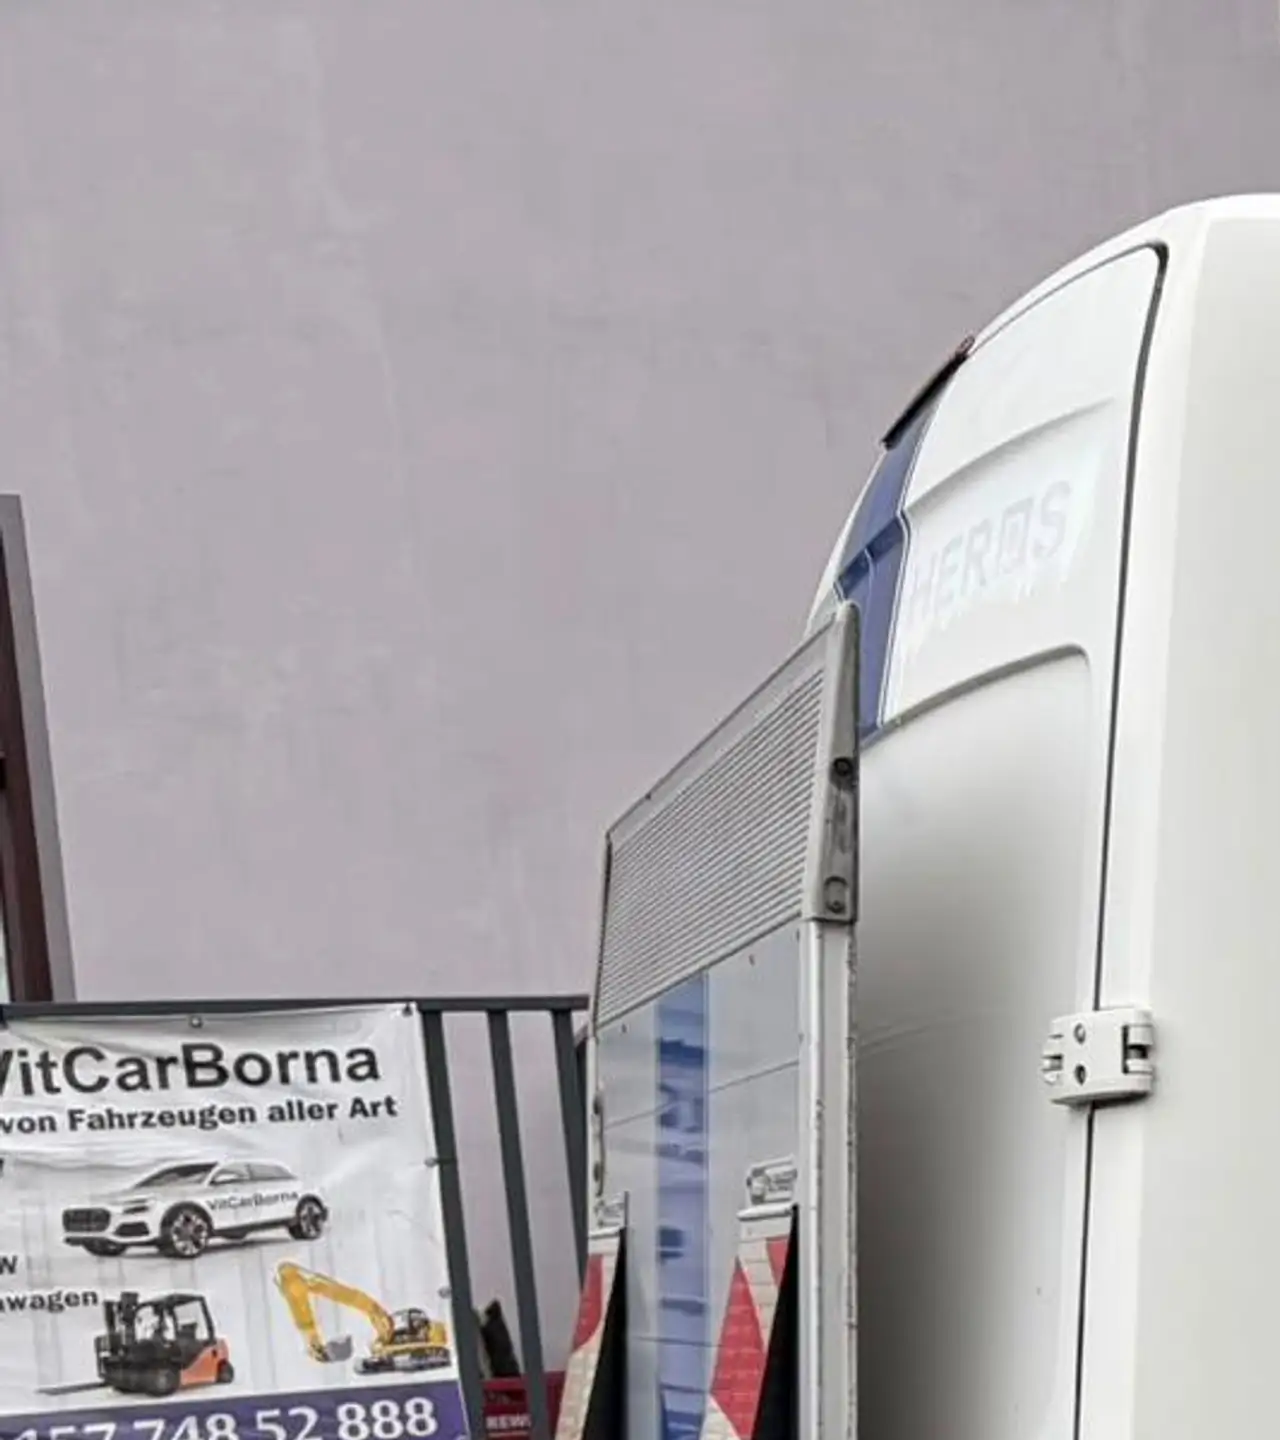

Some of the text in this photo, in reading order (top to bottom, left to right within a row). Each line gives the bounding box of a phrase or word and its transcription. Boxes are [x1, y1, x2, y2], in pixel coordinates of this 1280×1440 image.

[67, 1104, 257, 1131] Fahrzeugen
[267, 1098, 338, 1122] aller
[349, 1095, 398, 1119] Art
